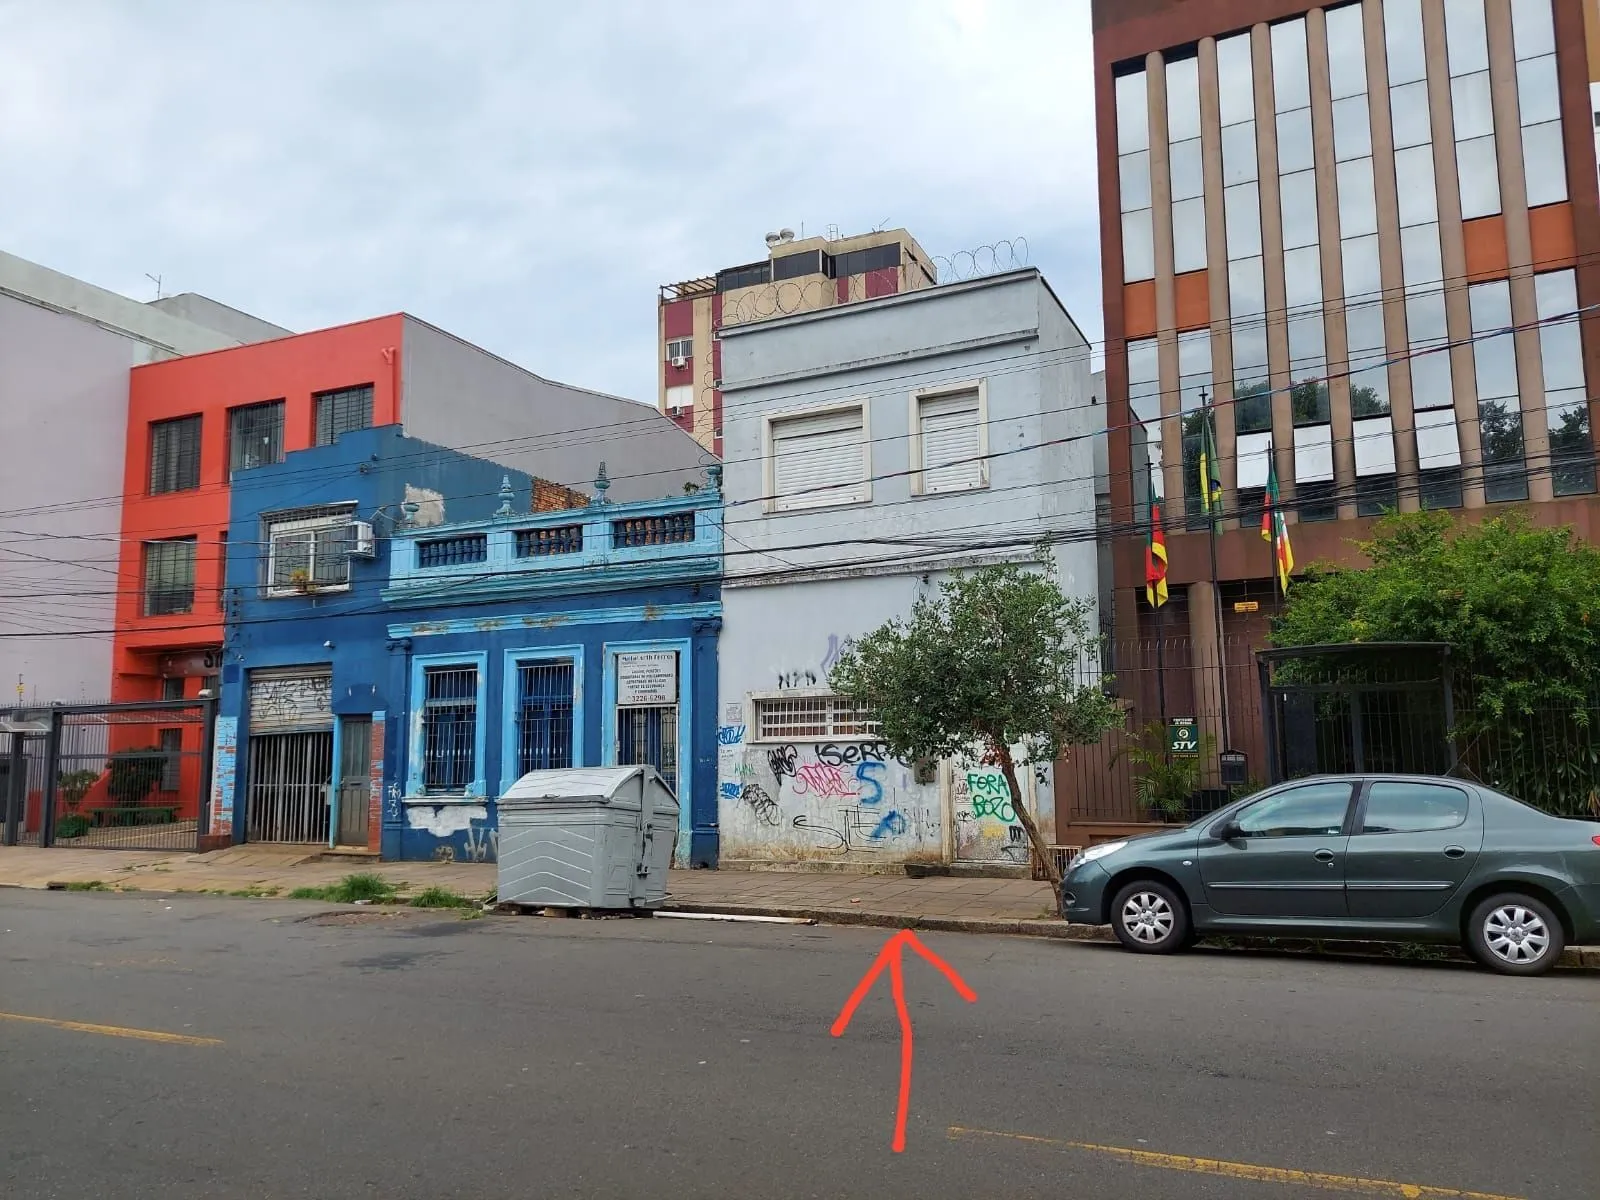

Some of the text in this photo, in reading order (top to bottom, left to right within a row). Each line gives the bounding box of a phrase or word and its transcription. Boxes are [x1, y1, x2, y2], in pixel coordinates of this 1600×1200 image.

[1172, 741, 1197, 750] STV
[967, 773, 1010, 797] FORA
[972, 794, 1016, 823] BOZO
